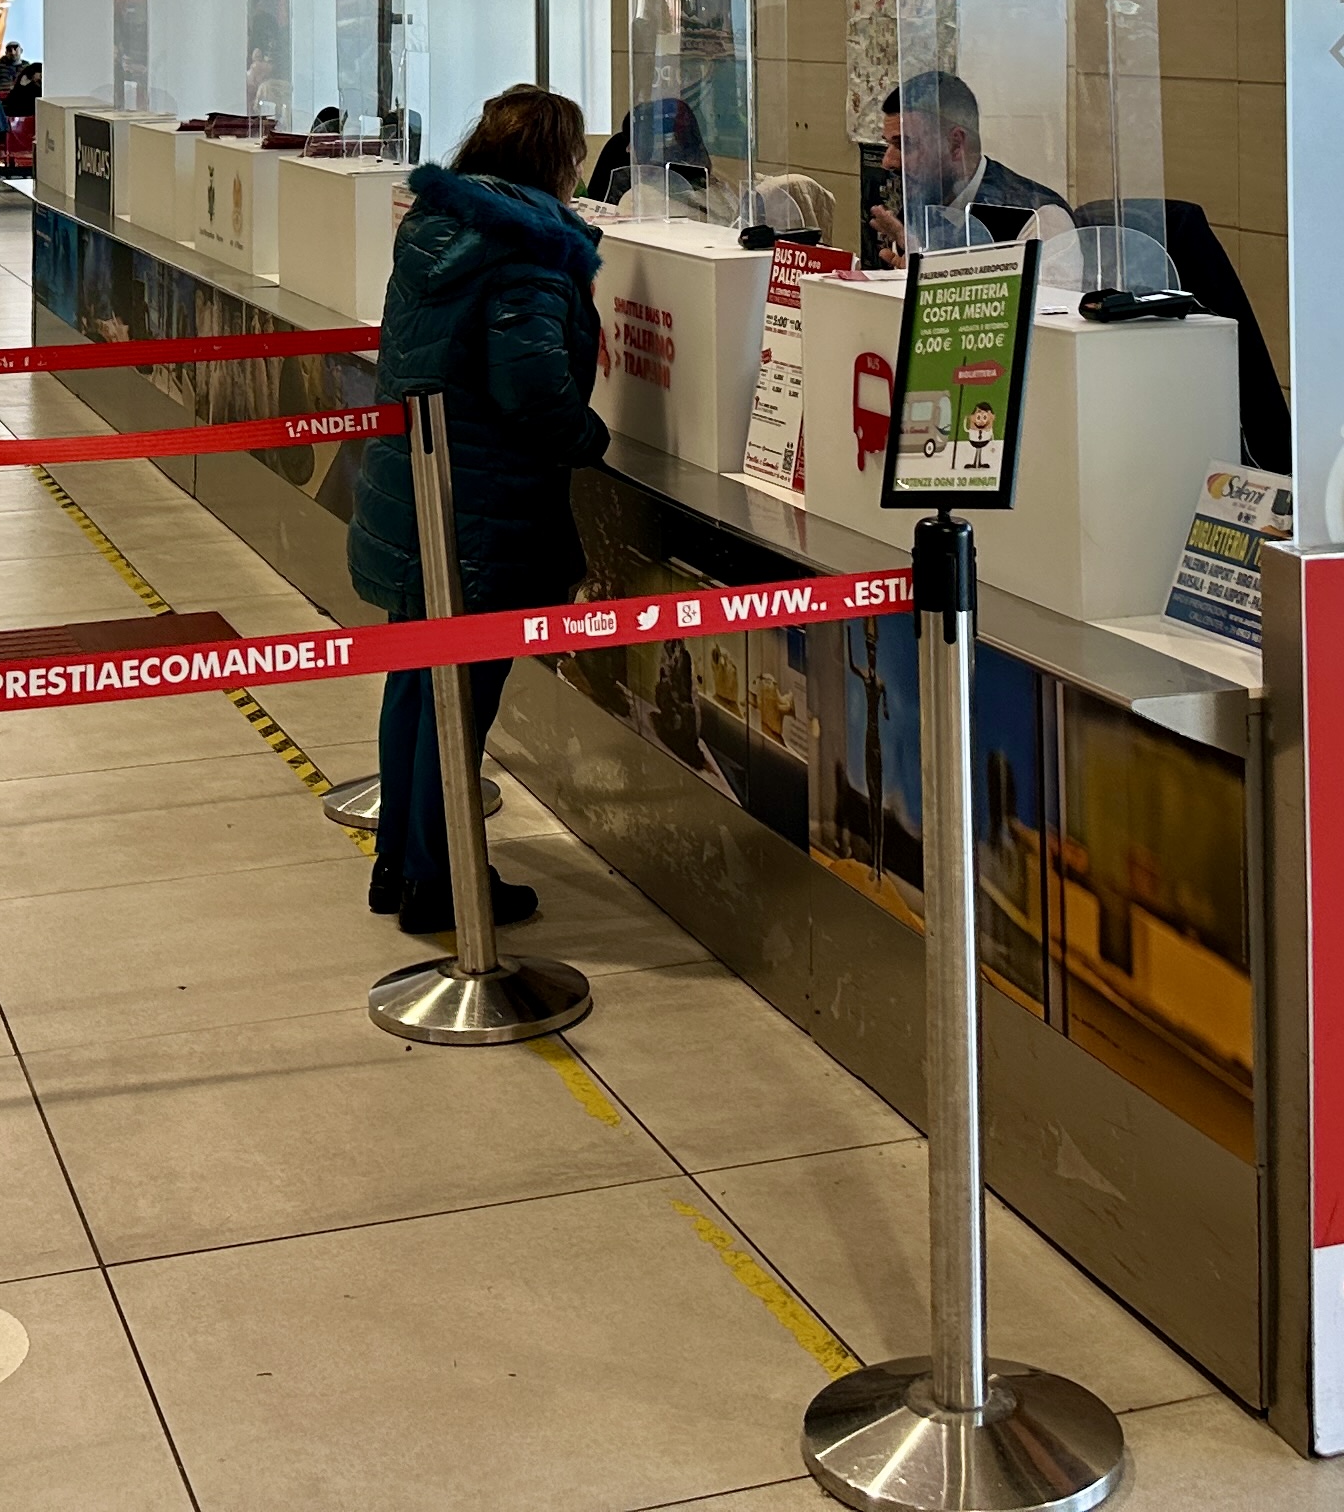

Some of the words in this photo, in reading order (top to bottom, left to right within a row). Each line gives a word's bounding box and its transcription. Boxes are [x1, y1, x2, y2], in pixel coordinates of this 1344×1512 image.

[774, 248, 793, 265] BUS
[794, 251, 807, 267] TO
[920, 288, 934, 306] IN
[936, 282, 1009, 303] BIGLIETTERIA
[645, 305, 660, 326] BUS
[661, 310, 673, 329] TO
[923, 302, 960, 323] COSTA
[963, 300, 1005, 321] MENO!
[623, 323, 675, 363] PALERMO
[933, 477, 955, 487] OGNI
[956, 477, 967, 487] 30
[1221, 474, 1267, 506] Salemi
[562, 609, 618, 638] YouTube
